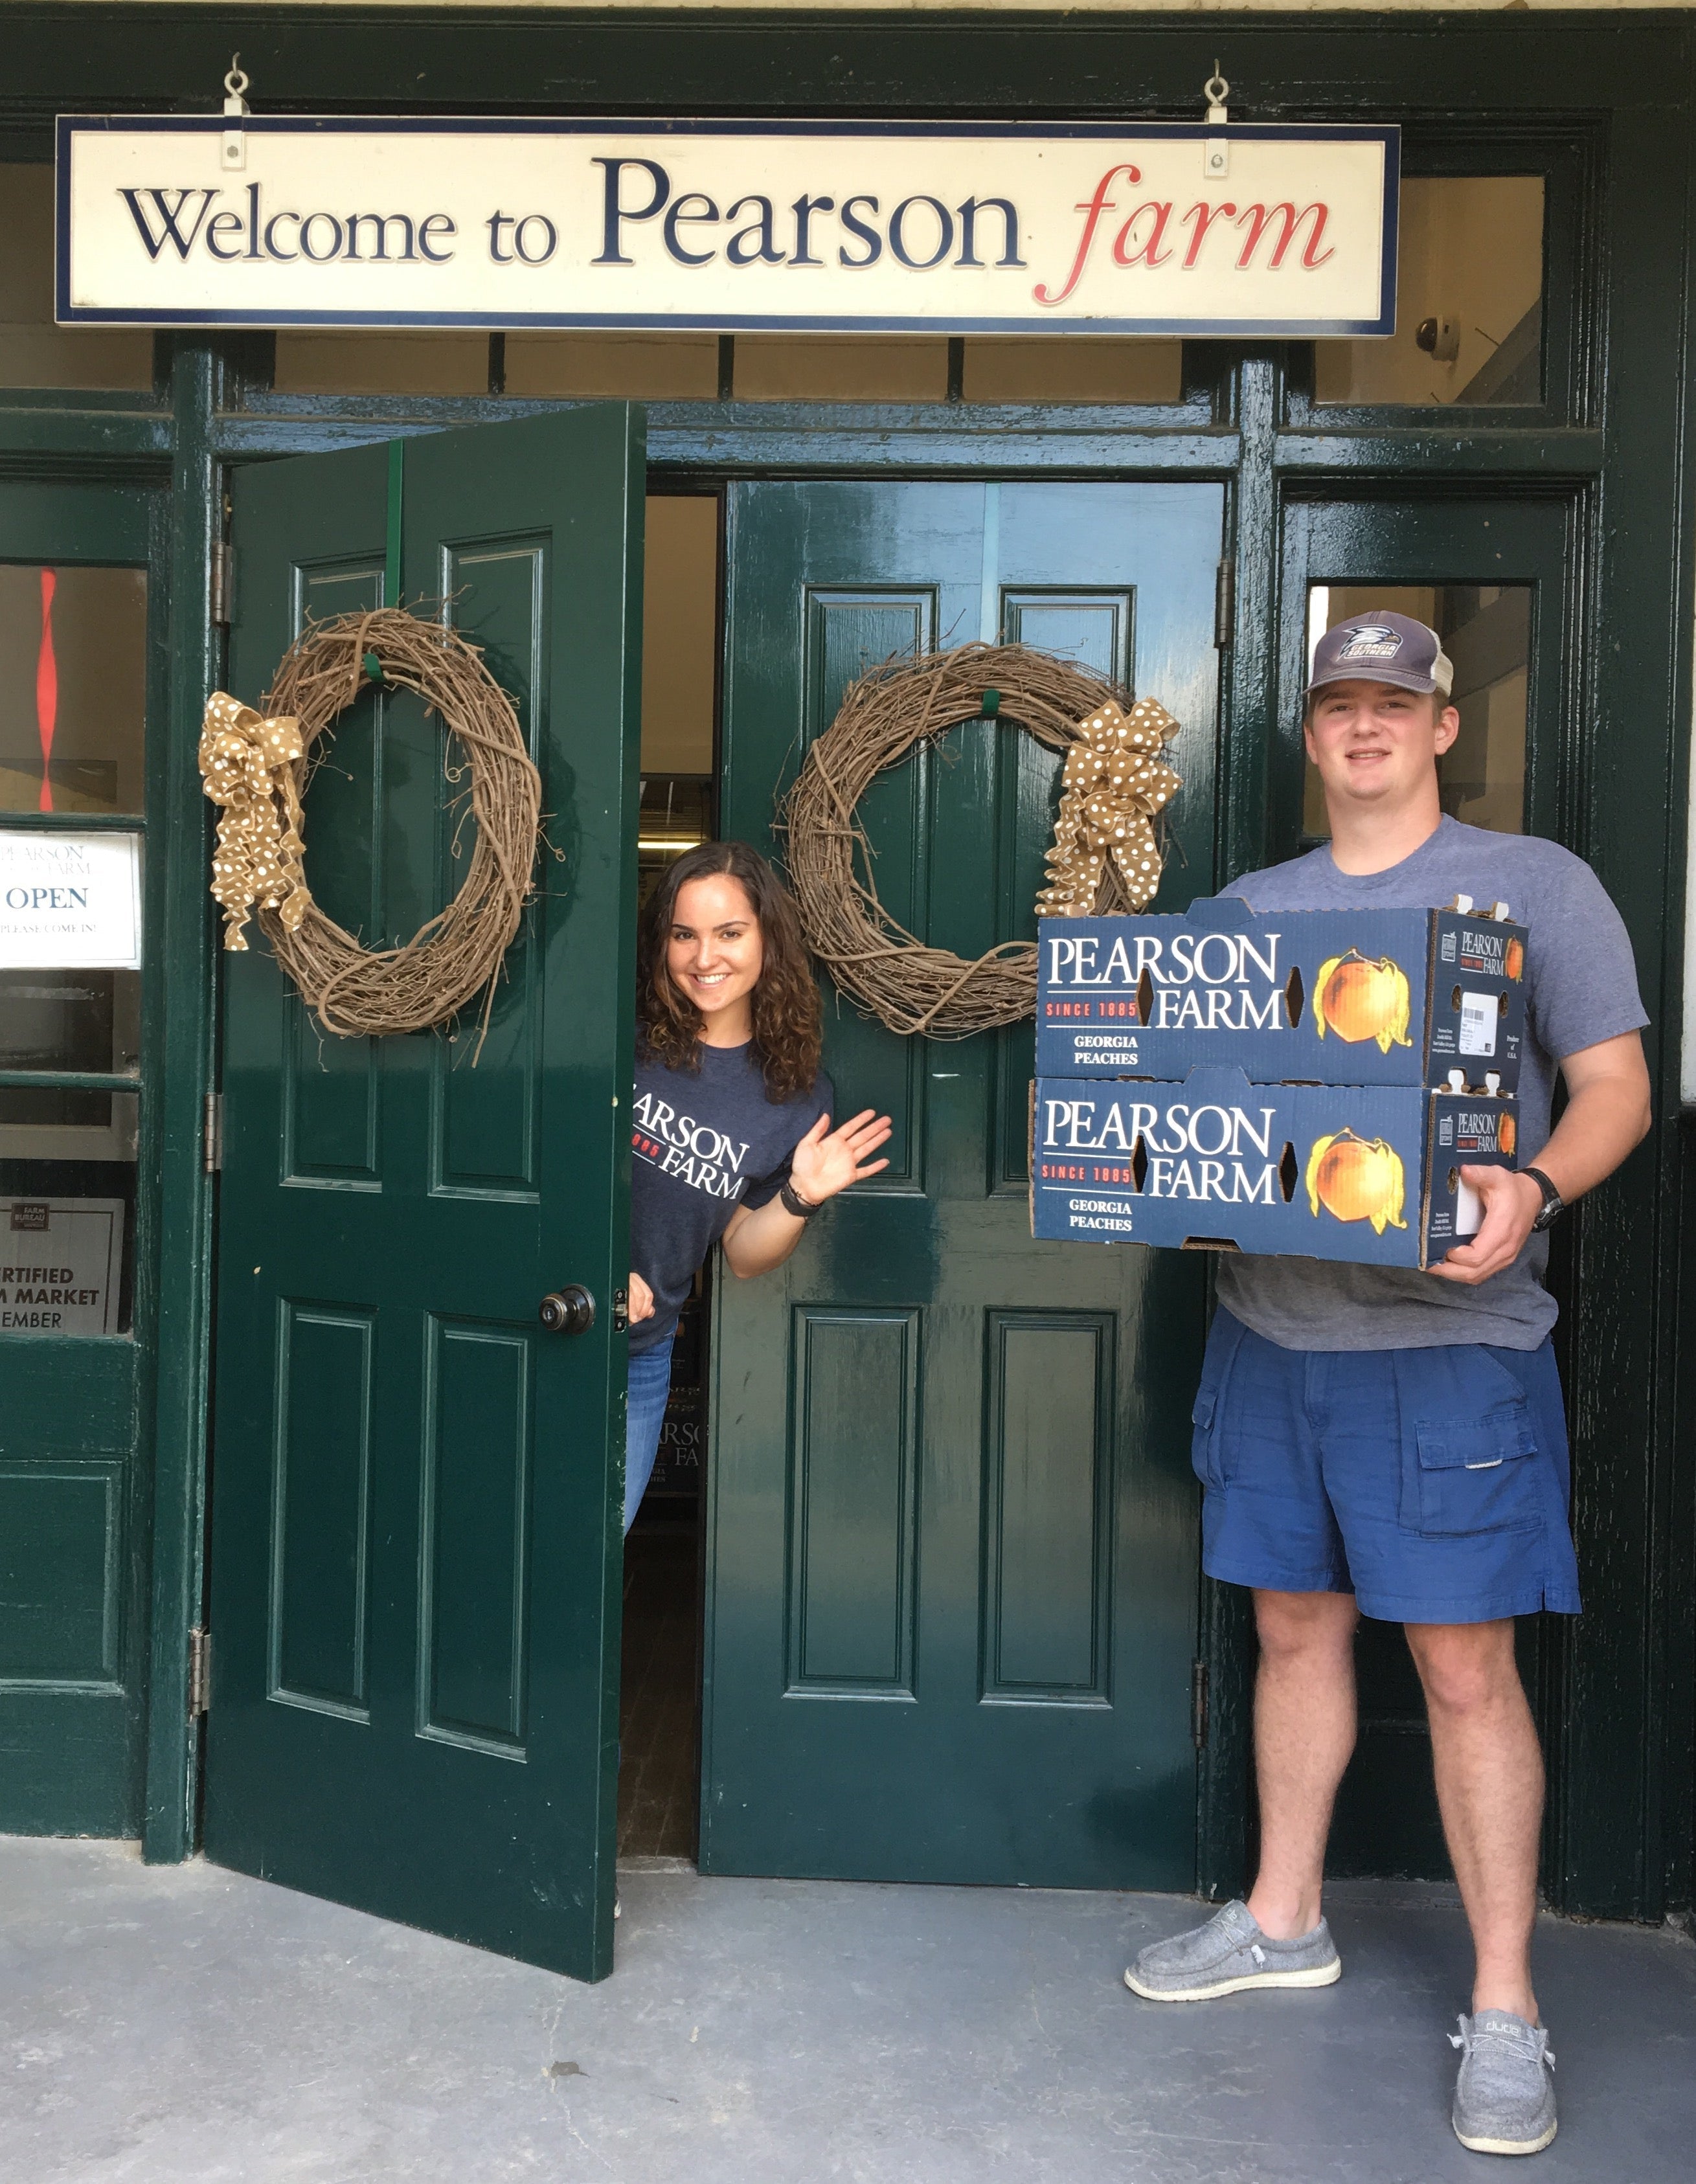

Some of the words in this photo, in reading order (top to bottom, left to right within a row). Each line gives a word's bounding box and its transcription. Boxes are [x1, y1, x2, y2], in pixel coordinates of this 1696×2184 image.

[118, 182, 457, 264] Welcome
[486, 208, 558, 264] to
[589, 156, 1028, 269] Pearson
[1033, 164, 1335, 306] farm
[6, 887, 89, 909] OPEN
[1462, 931, 1504, 958] PEARSON
[1047, 934, 1282, 985] PEARSON
[1483, 958, 1504, 976] FARM
[1046, 1002, 1091, 1017] SINCE
[1099, 1002, 1136, 1017] 1885
[1155, 989, 1284, 1030] FARM
[1074, 1036, 1138, 1048] GEORGIA
[1074, 1052, 1138, 1065] PEACHES
[633, 1091, 750, 1173] ARSON
[1043, 1100, 1276, 1158] PEARSON
[1457, 1113, 1495, 1134] PEARSON
[1477, 1136, 1497, 1153] FARM
[658, 1145, 745, 1200] FARM
[1042, 1165, 1085, 1180] SINCE
[1094, 1167, 1131, 1184] 1885
[1149, 1158, 1276, 1204] FARM
[1069, 1199, 1132, 1215] GEORGIA
[1069, 1216, 1132, 1231] PEACHES
[0, 1267, 74, 1284] RTIFIED
[14, 1288, 100, 1306] MARKET
[2, 1312, 62, 1328] EMBER
[1486, 2020, 1519, 2037] dude
